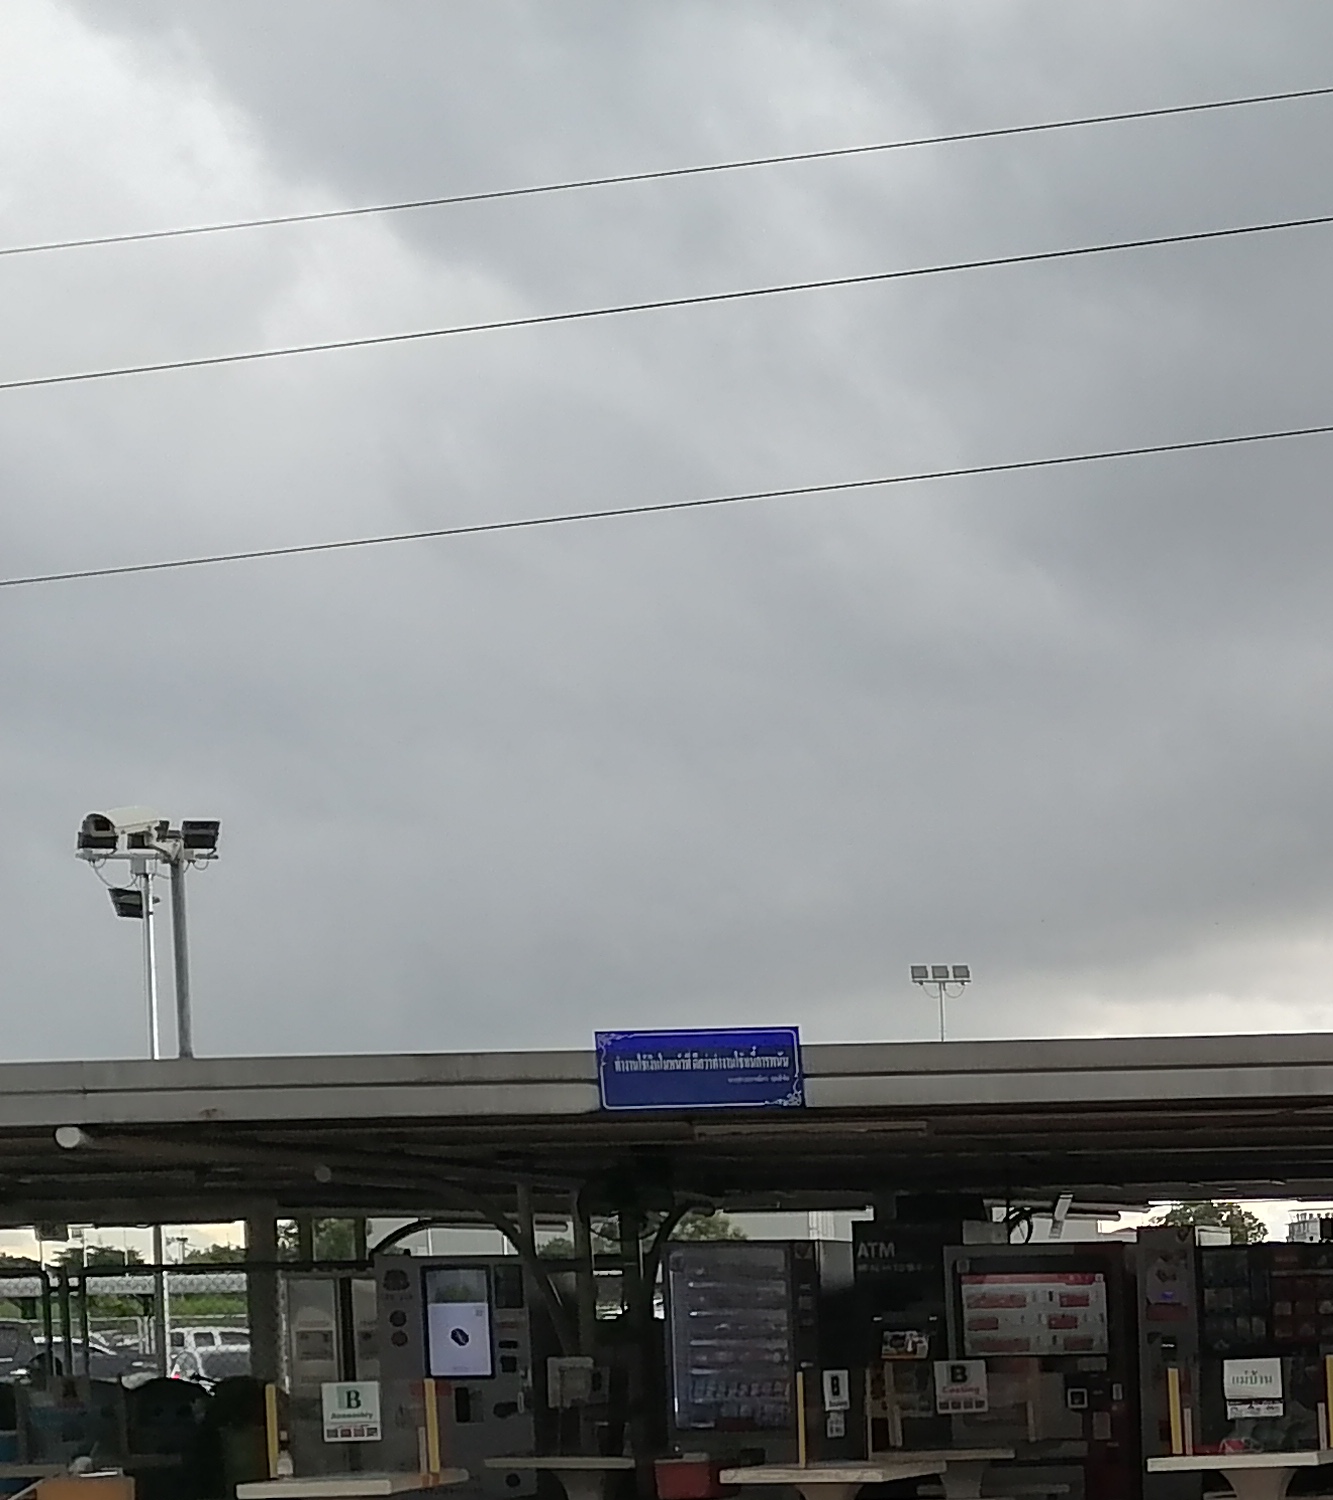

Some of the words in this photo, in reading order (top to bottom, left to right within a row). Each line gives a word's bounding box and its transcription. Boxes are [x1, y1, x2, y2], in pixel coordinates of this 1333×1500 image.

[856, 1242, 896, 1259] ATM
[950, 1365, 968, 1383] B
[1231, 1369, 1273, 1385] แม่บ้าน
[346, 1389, 361, 1410] B
